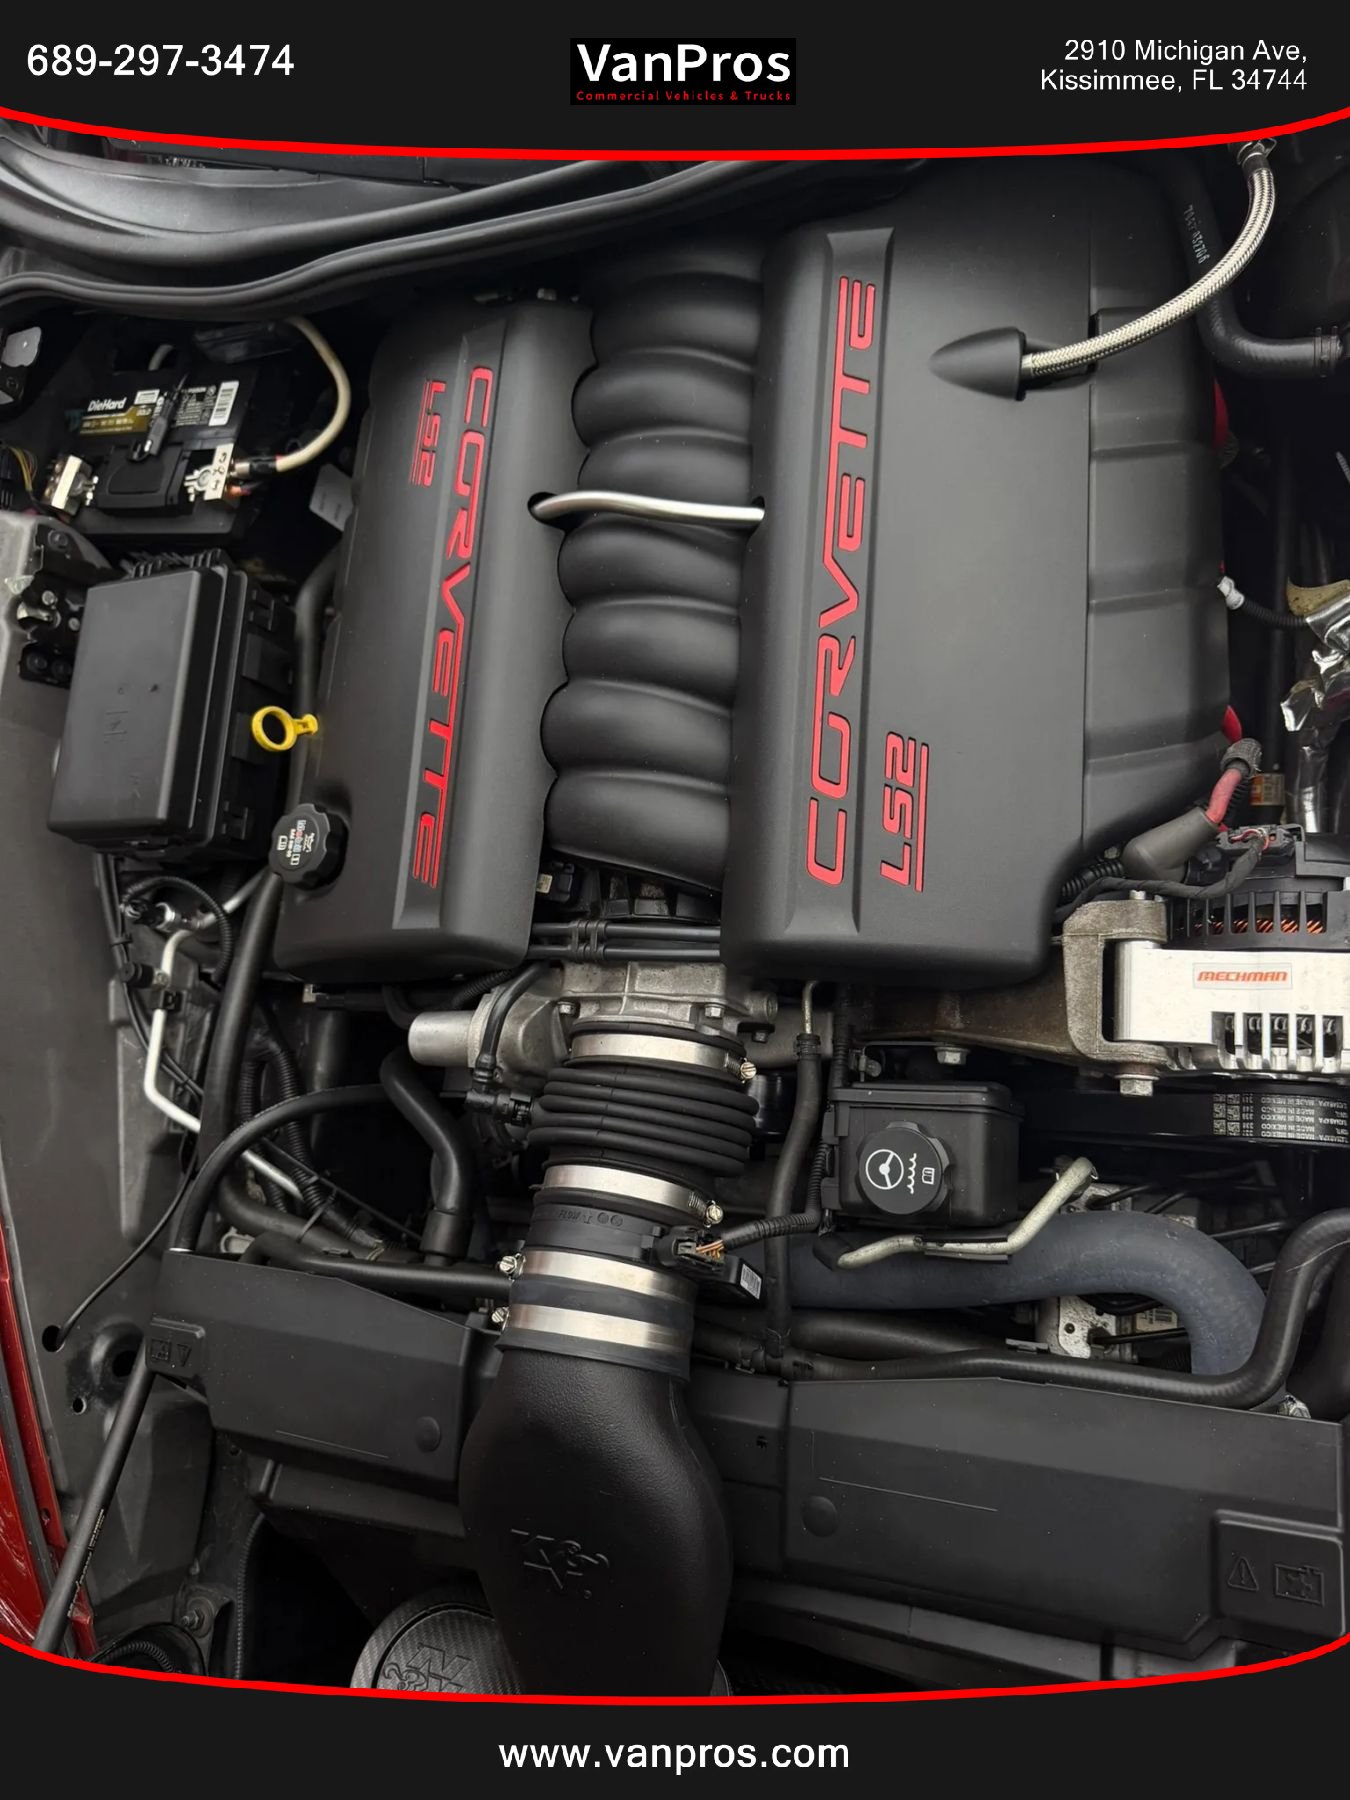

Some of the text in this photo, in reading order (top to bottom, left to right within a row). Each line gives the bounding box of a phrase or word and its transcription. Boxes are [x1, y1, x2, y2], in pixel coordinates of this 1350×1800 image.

[88, 397, 127, 411] DieHard
[417, 381, 447, 487] LS2
[412, 367, 493, 887] CORVETTE
[806, 277, 876, 886] CORVETTE
[879, 735, 917, 885] LS2
[1197, 970, 1287, 982] MECHMAN
